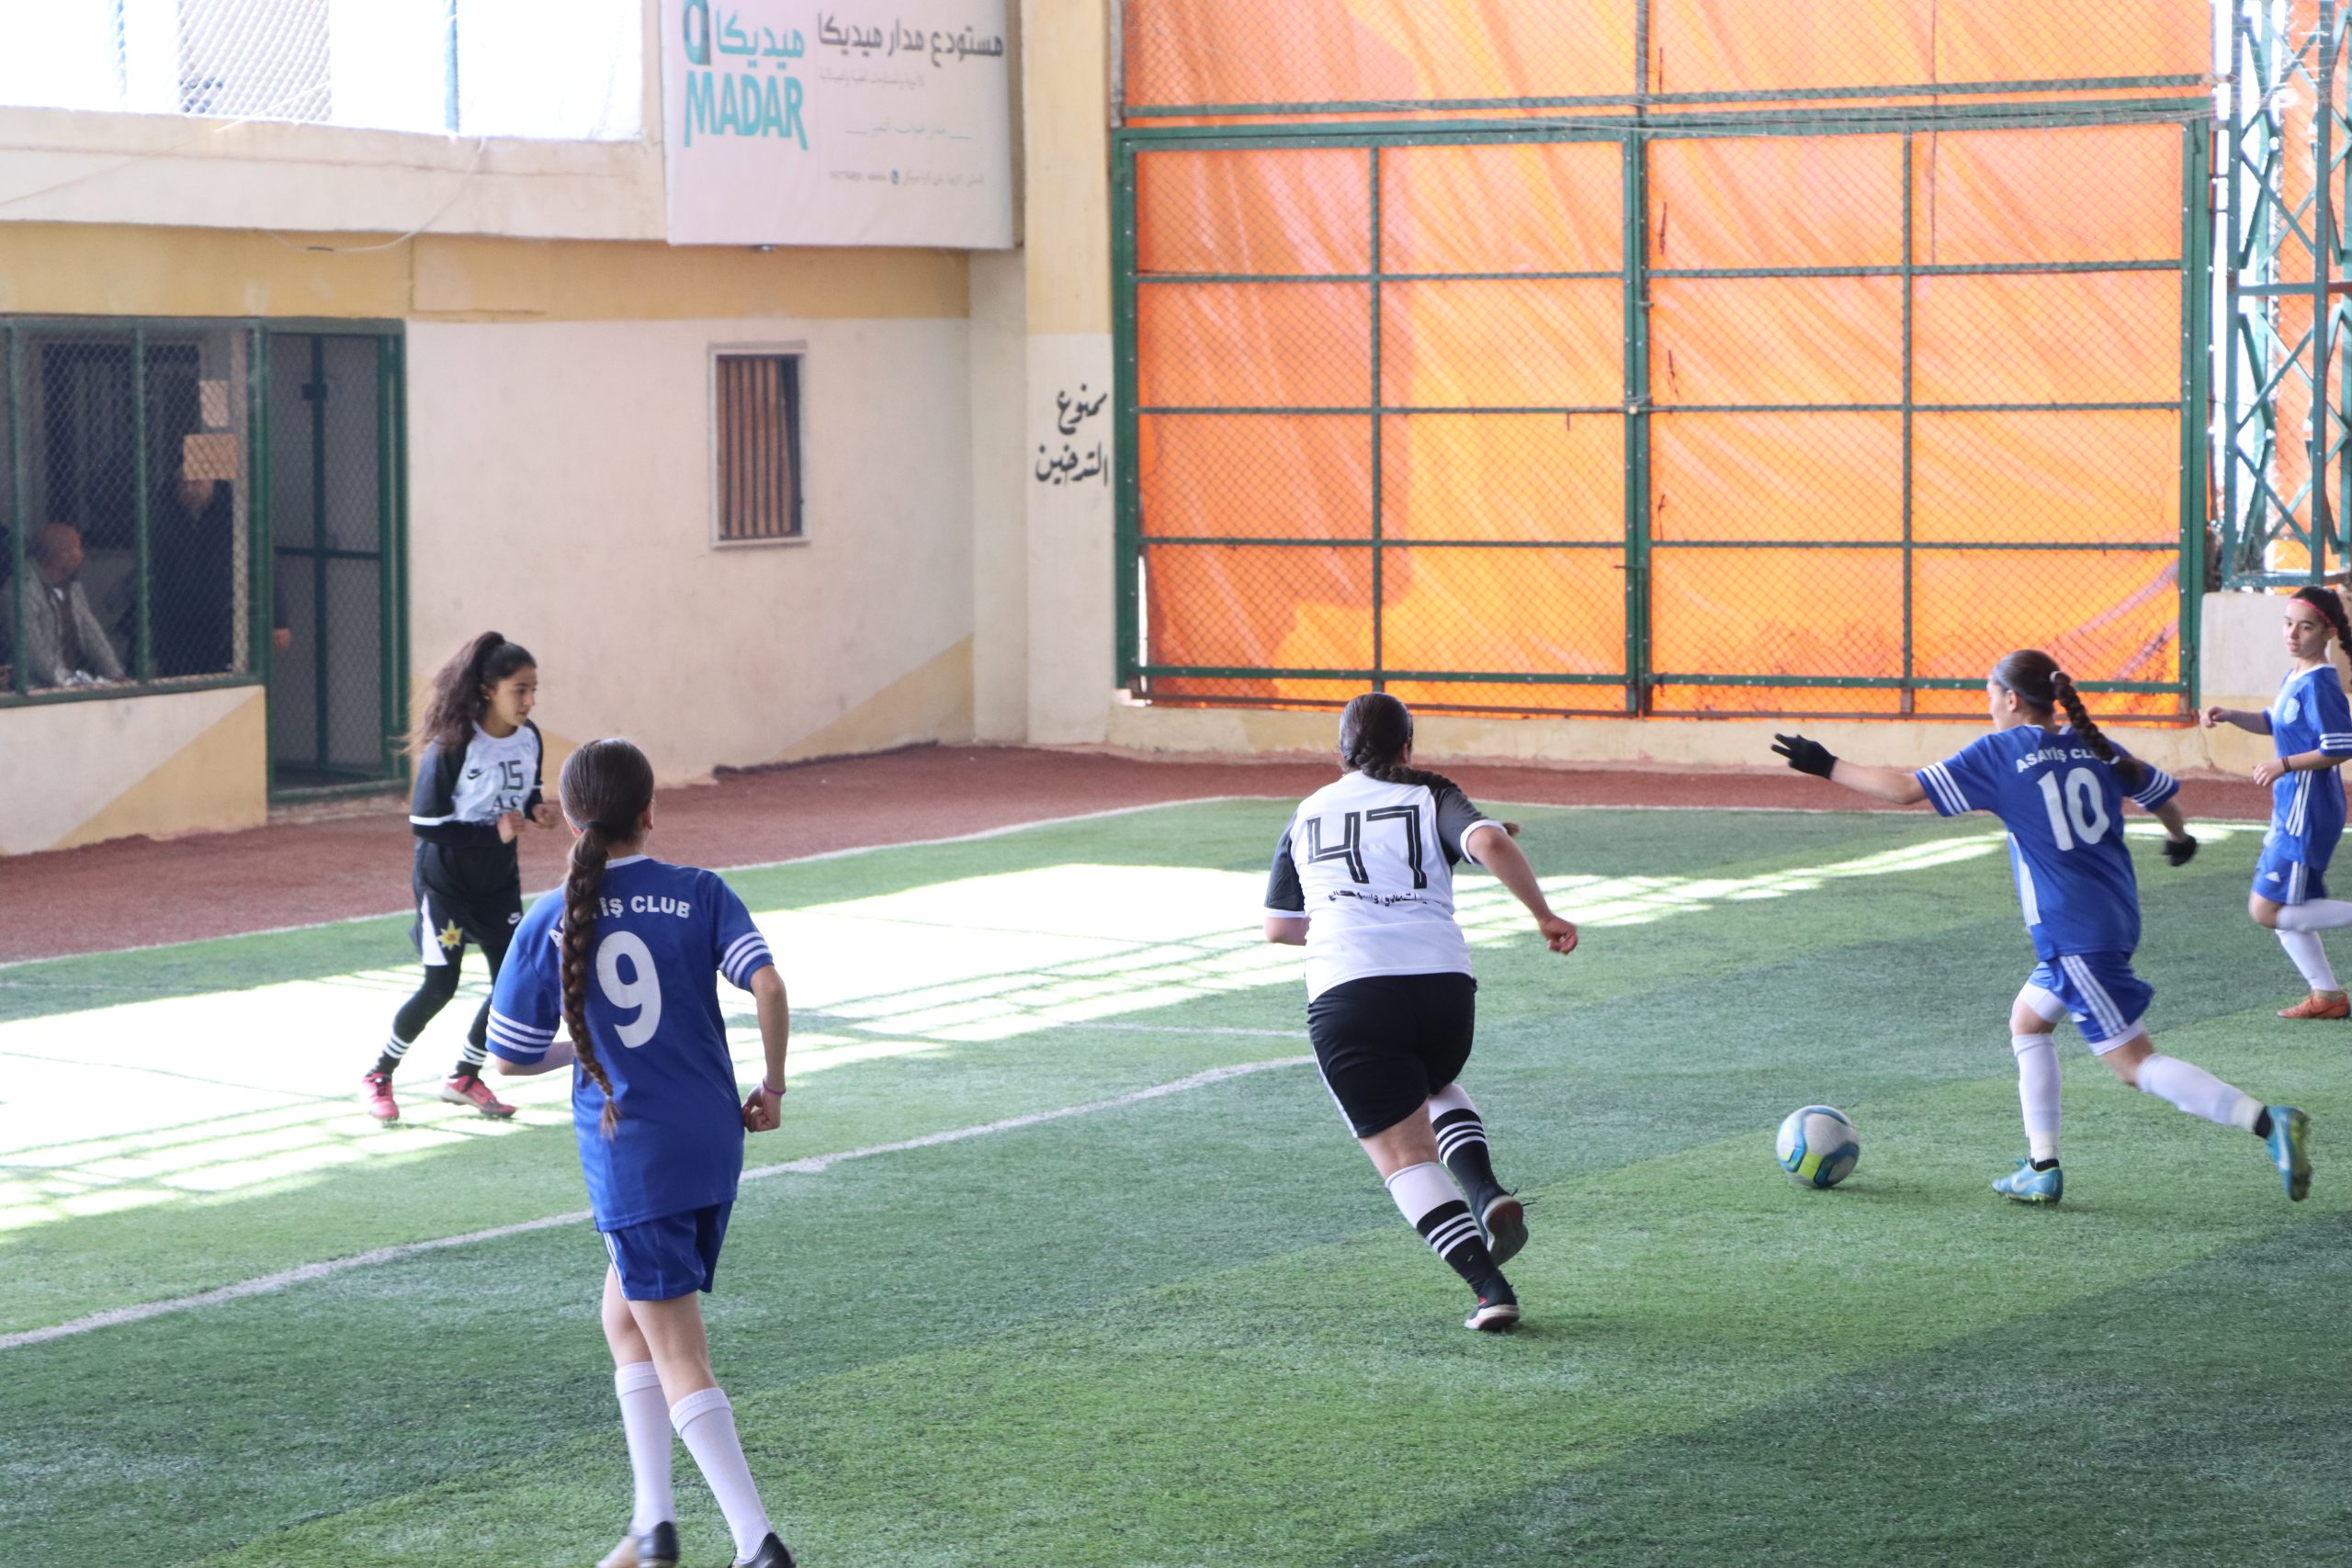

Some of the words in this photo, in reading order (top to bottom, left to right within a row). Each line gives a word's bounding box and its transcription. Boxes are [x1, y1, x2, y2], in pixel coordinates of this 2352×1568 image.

[716, 7, 805, 70] ميديكا
[818, 11, 882, 57] ميديكا
[888, 17, 924, 57] مدار
[931, 25, 1003, 67] مستودع
[684, 70, 808, 151] MADAR
[1057, 383, 1107, 435] ممنوع
[498, 759, 524, 790] 15
[2070, 748, 2120, 765] CL
[2037, 767, 2110, 851] 10
[1307, 805, 1427, 889] 47
[630, 896, 691, 919] CLUB
[595, 931, 662, 1049] 9
